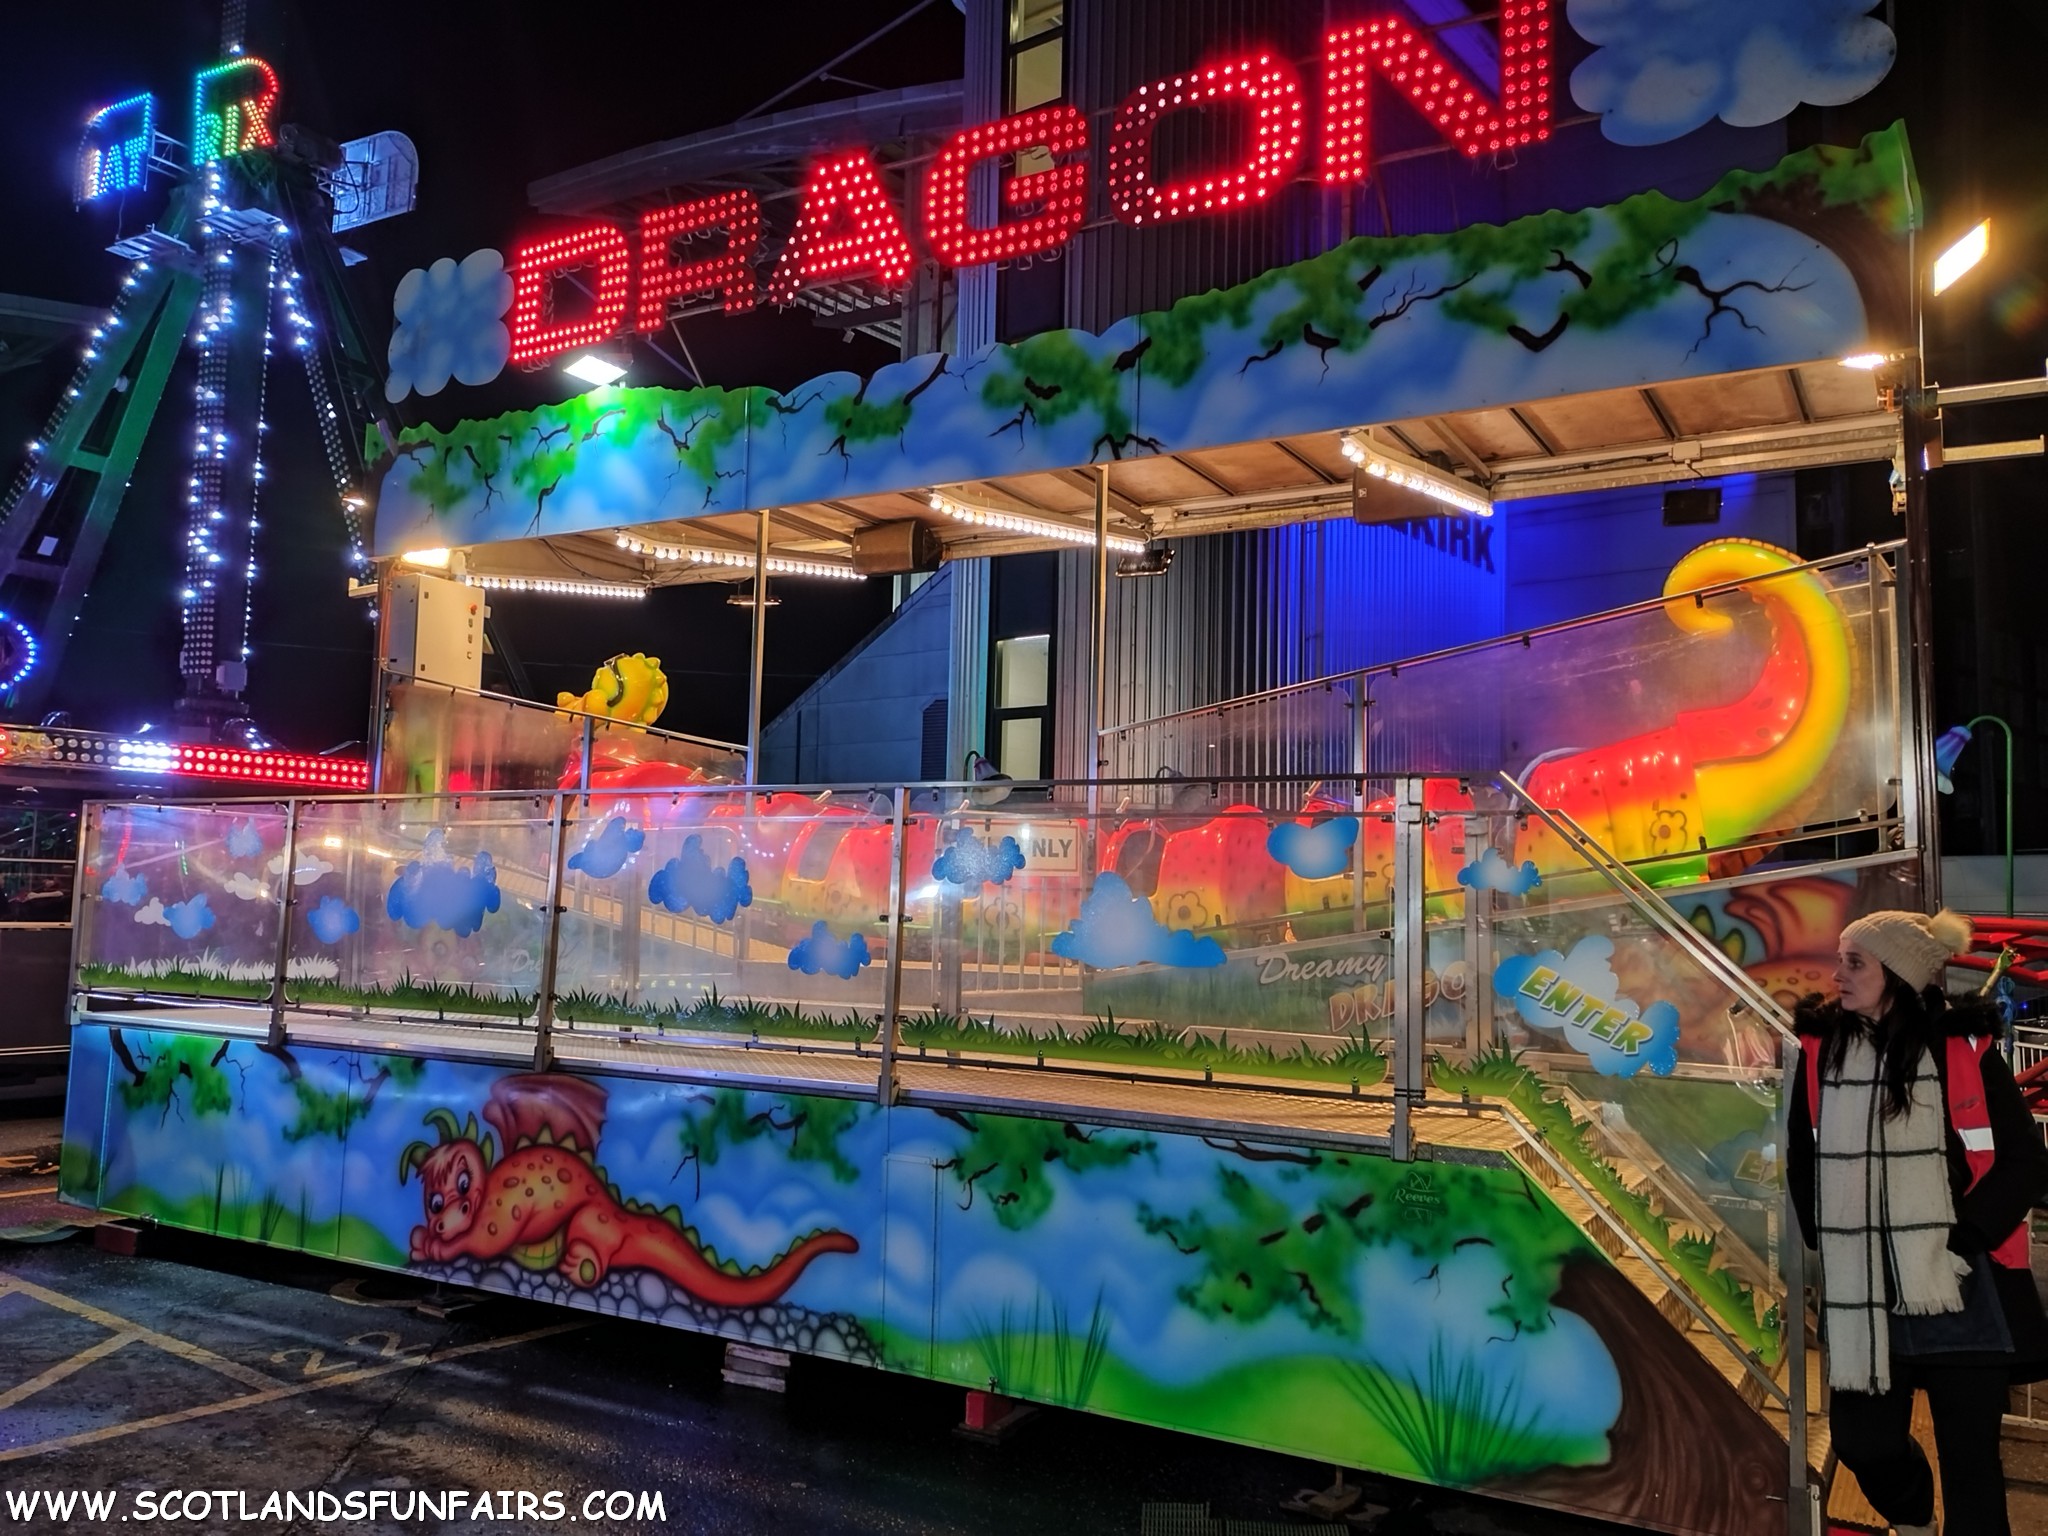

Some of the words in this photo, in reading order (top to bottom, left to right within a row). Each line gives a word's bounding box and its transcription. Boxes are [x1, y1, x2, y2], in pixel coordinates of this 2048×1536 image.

[508, 0, 1554, 362] DRAGON
[1257, 952, 1387, 985] Dreamy
[1518, 965, 1654, 1056] ENTER
